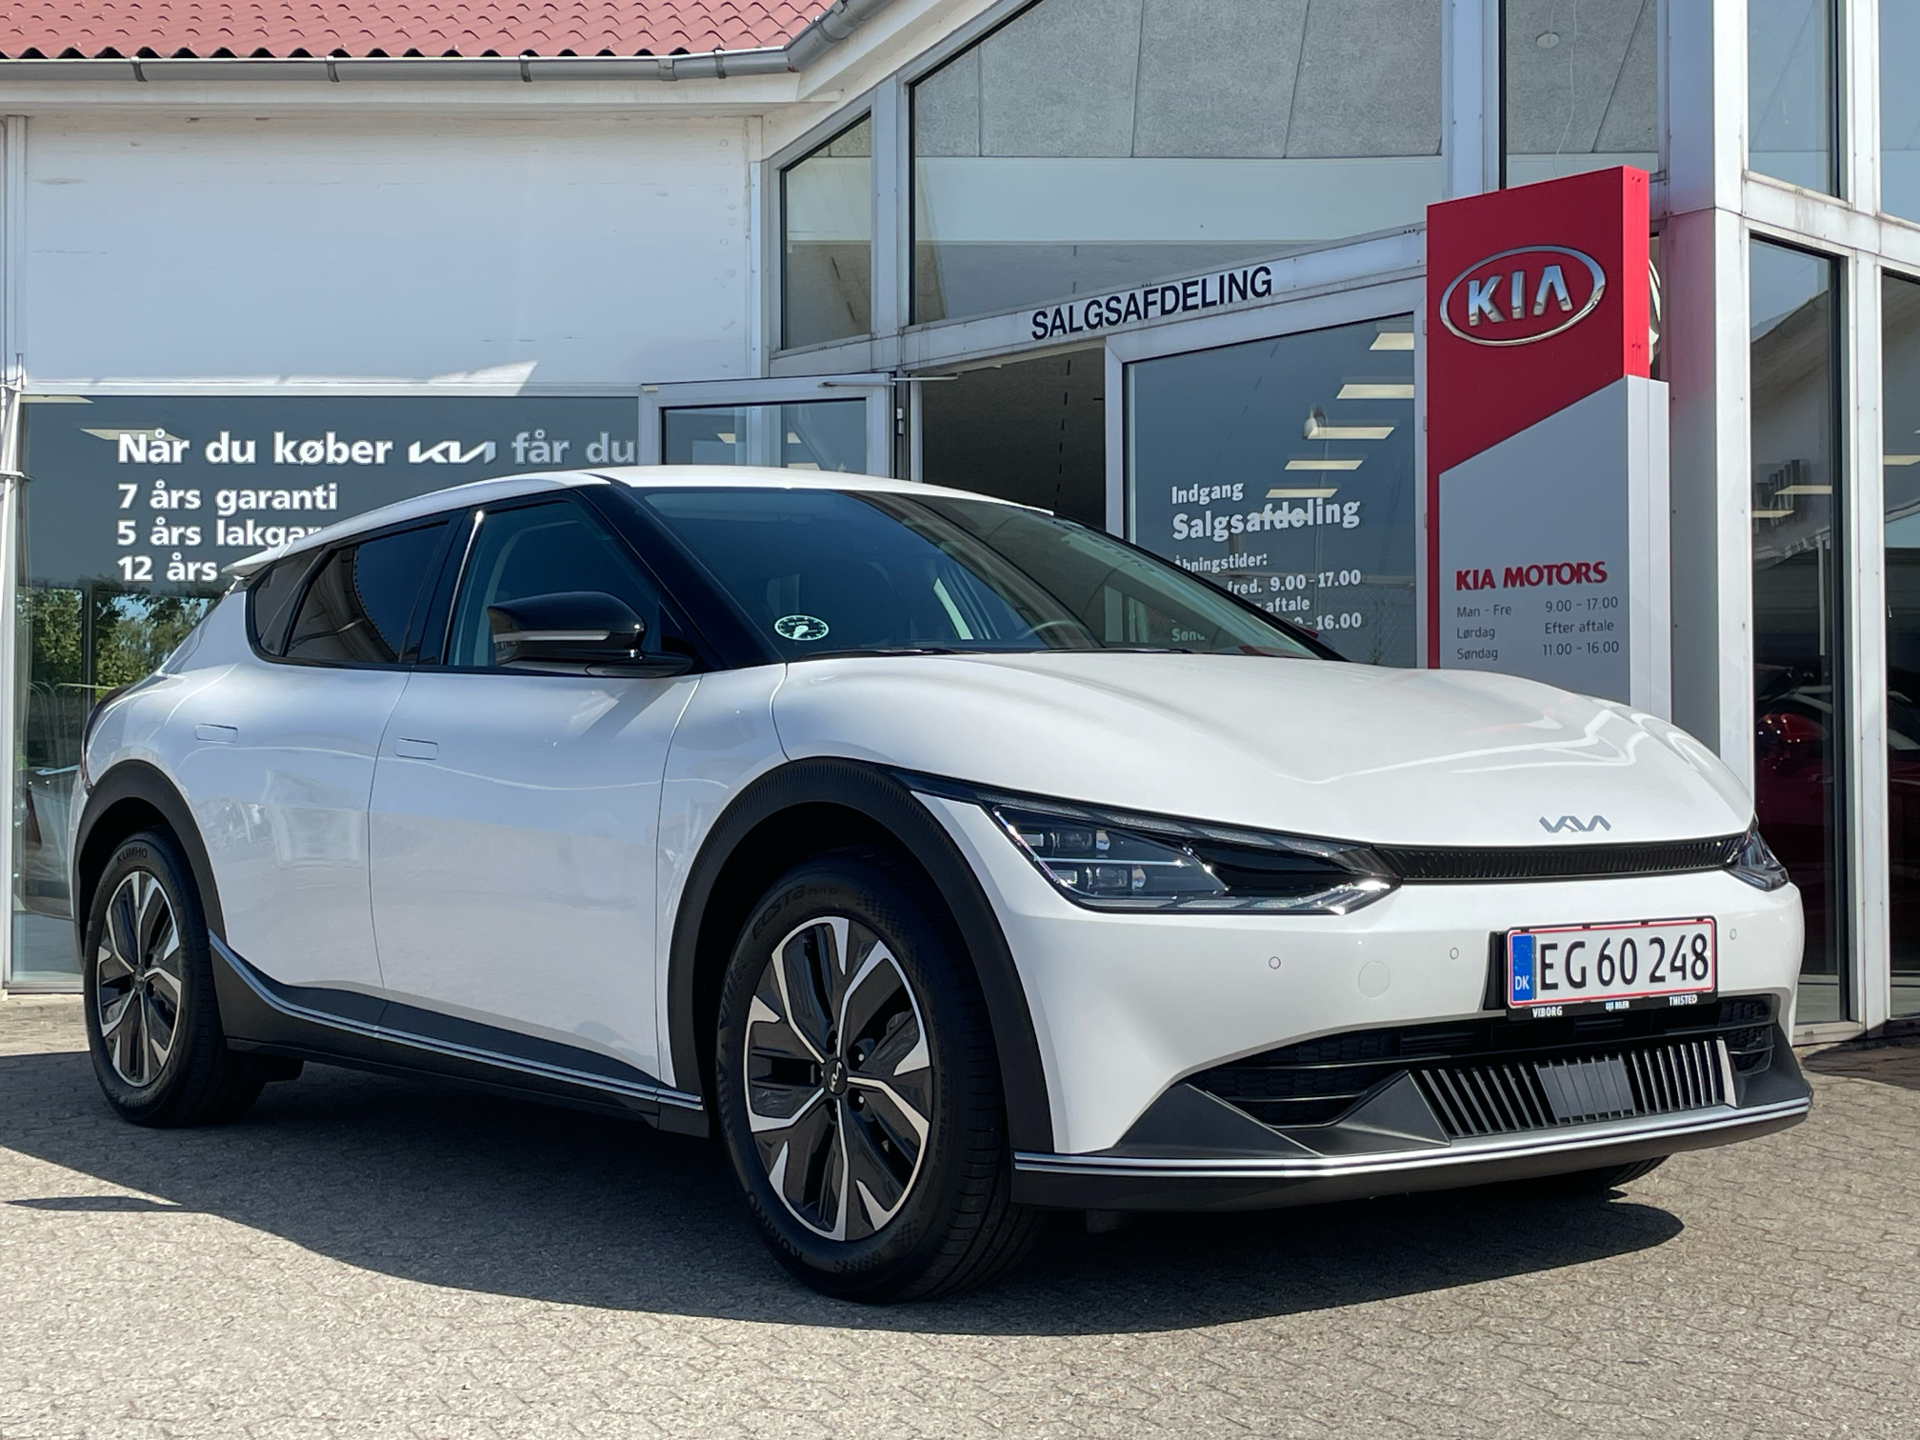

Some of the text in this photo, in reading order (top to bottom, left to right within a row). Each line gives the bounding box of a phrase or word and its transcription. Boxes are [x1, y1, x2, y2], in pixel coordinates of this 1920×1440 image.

[1032, 267, 1272, 340] SALGSAFDELING
[1468, 265, 1573, 327] KIA
[118, 428, 190, 463] Når
[205, 431, 256, 464] du
[273, 431, 393, 465] køber
[511, 428, 570, 464] får
[586, 431, 635, 464] du
[118, 479, 338, 517] 7 års garanti
[1171, 483, 1244, 505] Indgang
[1173, 498, 1360, 542] Salgsafdeling
[117, 520, 136, 546] 5
[150, 516, 201, 546] års
[117, 552, 218, 582] 12 års
[1456, 561, 1608, 591] KIA MOTORS
[1266, 596, 1310, 613] aftale
[1457, 607, 1480, 618] Man
[1493, 604, 1512, 616] Fre
[1545, 600, 1572, 613] 9.00
[1586, 597, 1618, 611] 17.00
[1171, 628, 1205, 641] Søn
[1456, 626, 1495, 640] Lørdag
[1545, 619, 1614, 634] Efter aftale
[1457, 647, 1498, 661] Søndag
[1542, 643, 1572, 656] 11.00
[1586, 641, 1619, 654] 16.00
[117, 847, 148, 865] KUMHO
[1540, 933, 1709, 991] EG 60 248
[1514, 975, 1530, 991] DK
[1669, 994, 1698, 1006] THISTED
[1532, 1006, 1563, 1019] VIBORG
